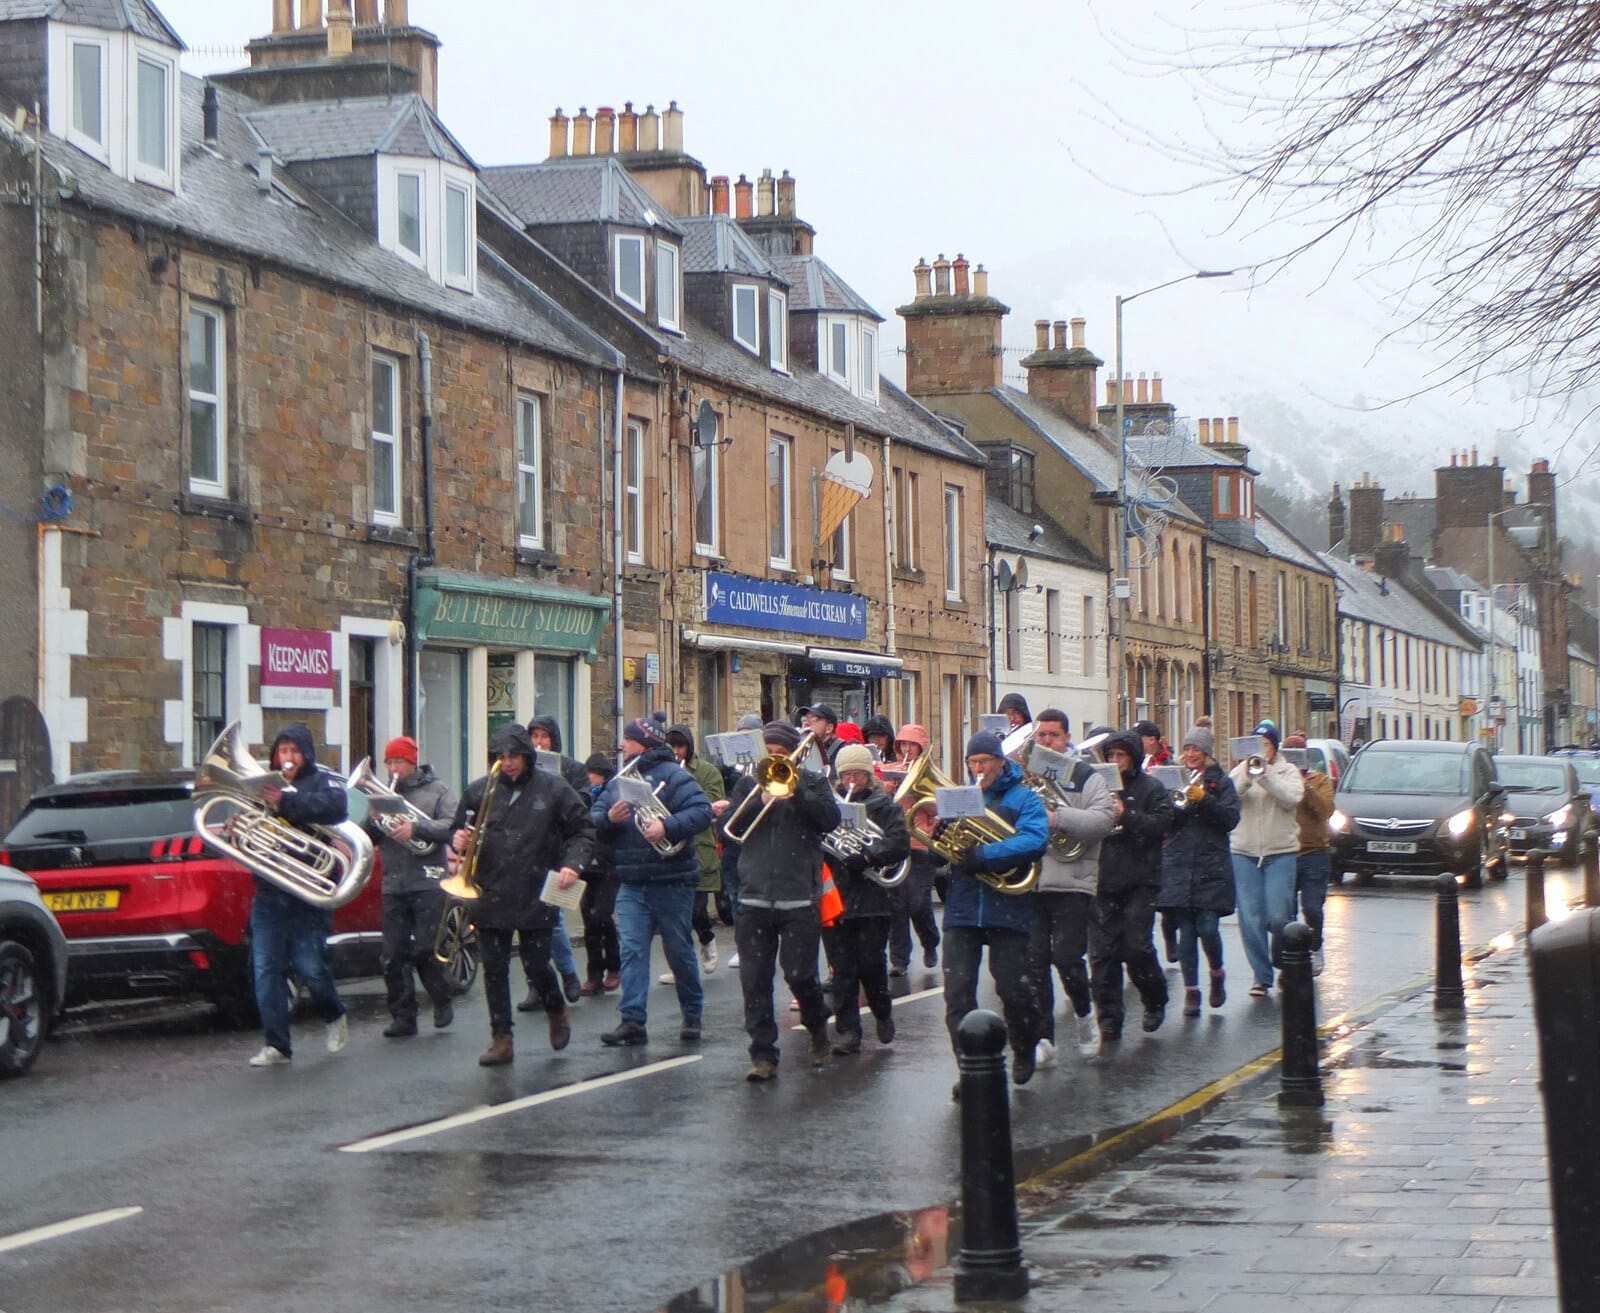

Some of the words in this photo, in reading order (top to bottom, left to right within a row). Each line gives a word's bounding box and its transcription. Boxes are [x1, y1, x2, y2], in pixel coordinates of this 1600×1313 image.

[434, 592, 534, 629] BUTTERCUP
[535, 604, 594, 636] STUDIO
[729, 590, 778, 614] CALDWELLS
[779, 595, 808, 618] Homemade
[808, 601, 821, 619] ICE
[821, 603, 847, 624] CREAM
[268, 643, 329, 674] KEEPSAKES
